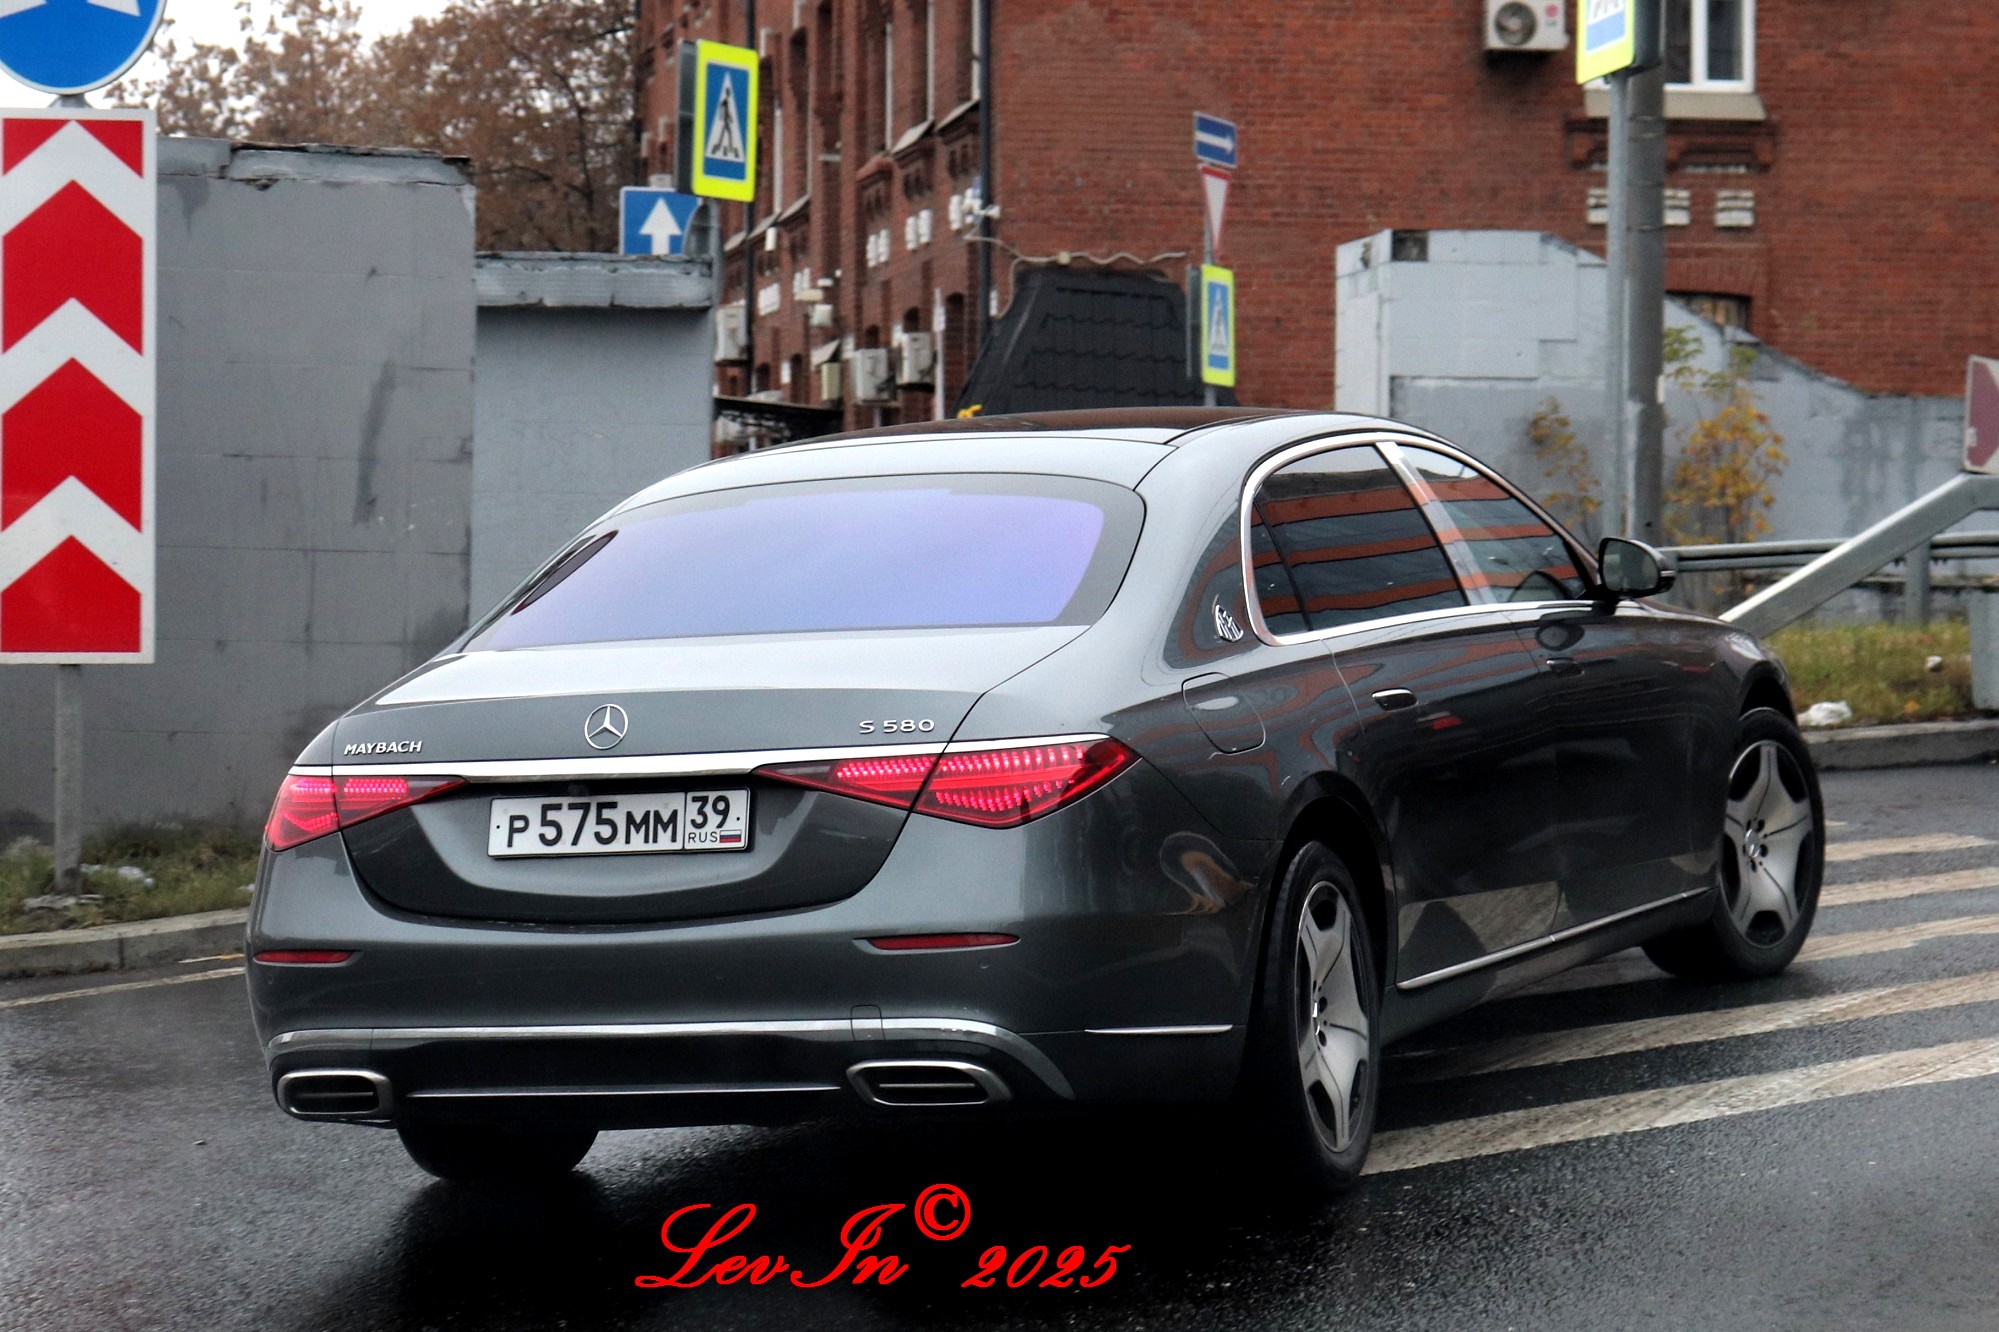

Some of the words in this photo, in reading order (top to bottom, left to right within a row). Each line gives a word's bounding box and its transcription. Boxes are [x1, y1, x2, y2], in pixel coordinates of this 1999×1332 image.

[859, 719, 875, 734] S
[883, 718, 935, 733] 580
[343, 740, 423, 756] MAYBACH
[690, 795, 731, 829] 39
[687, 830, 718, 844] RUS
